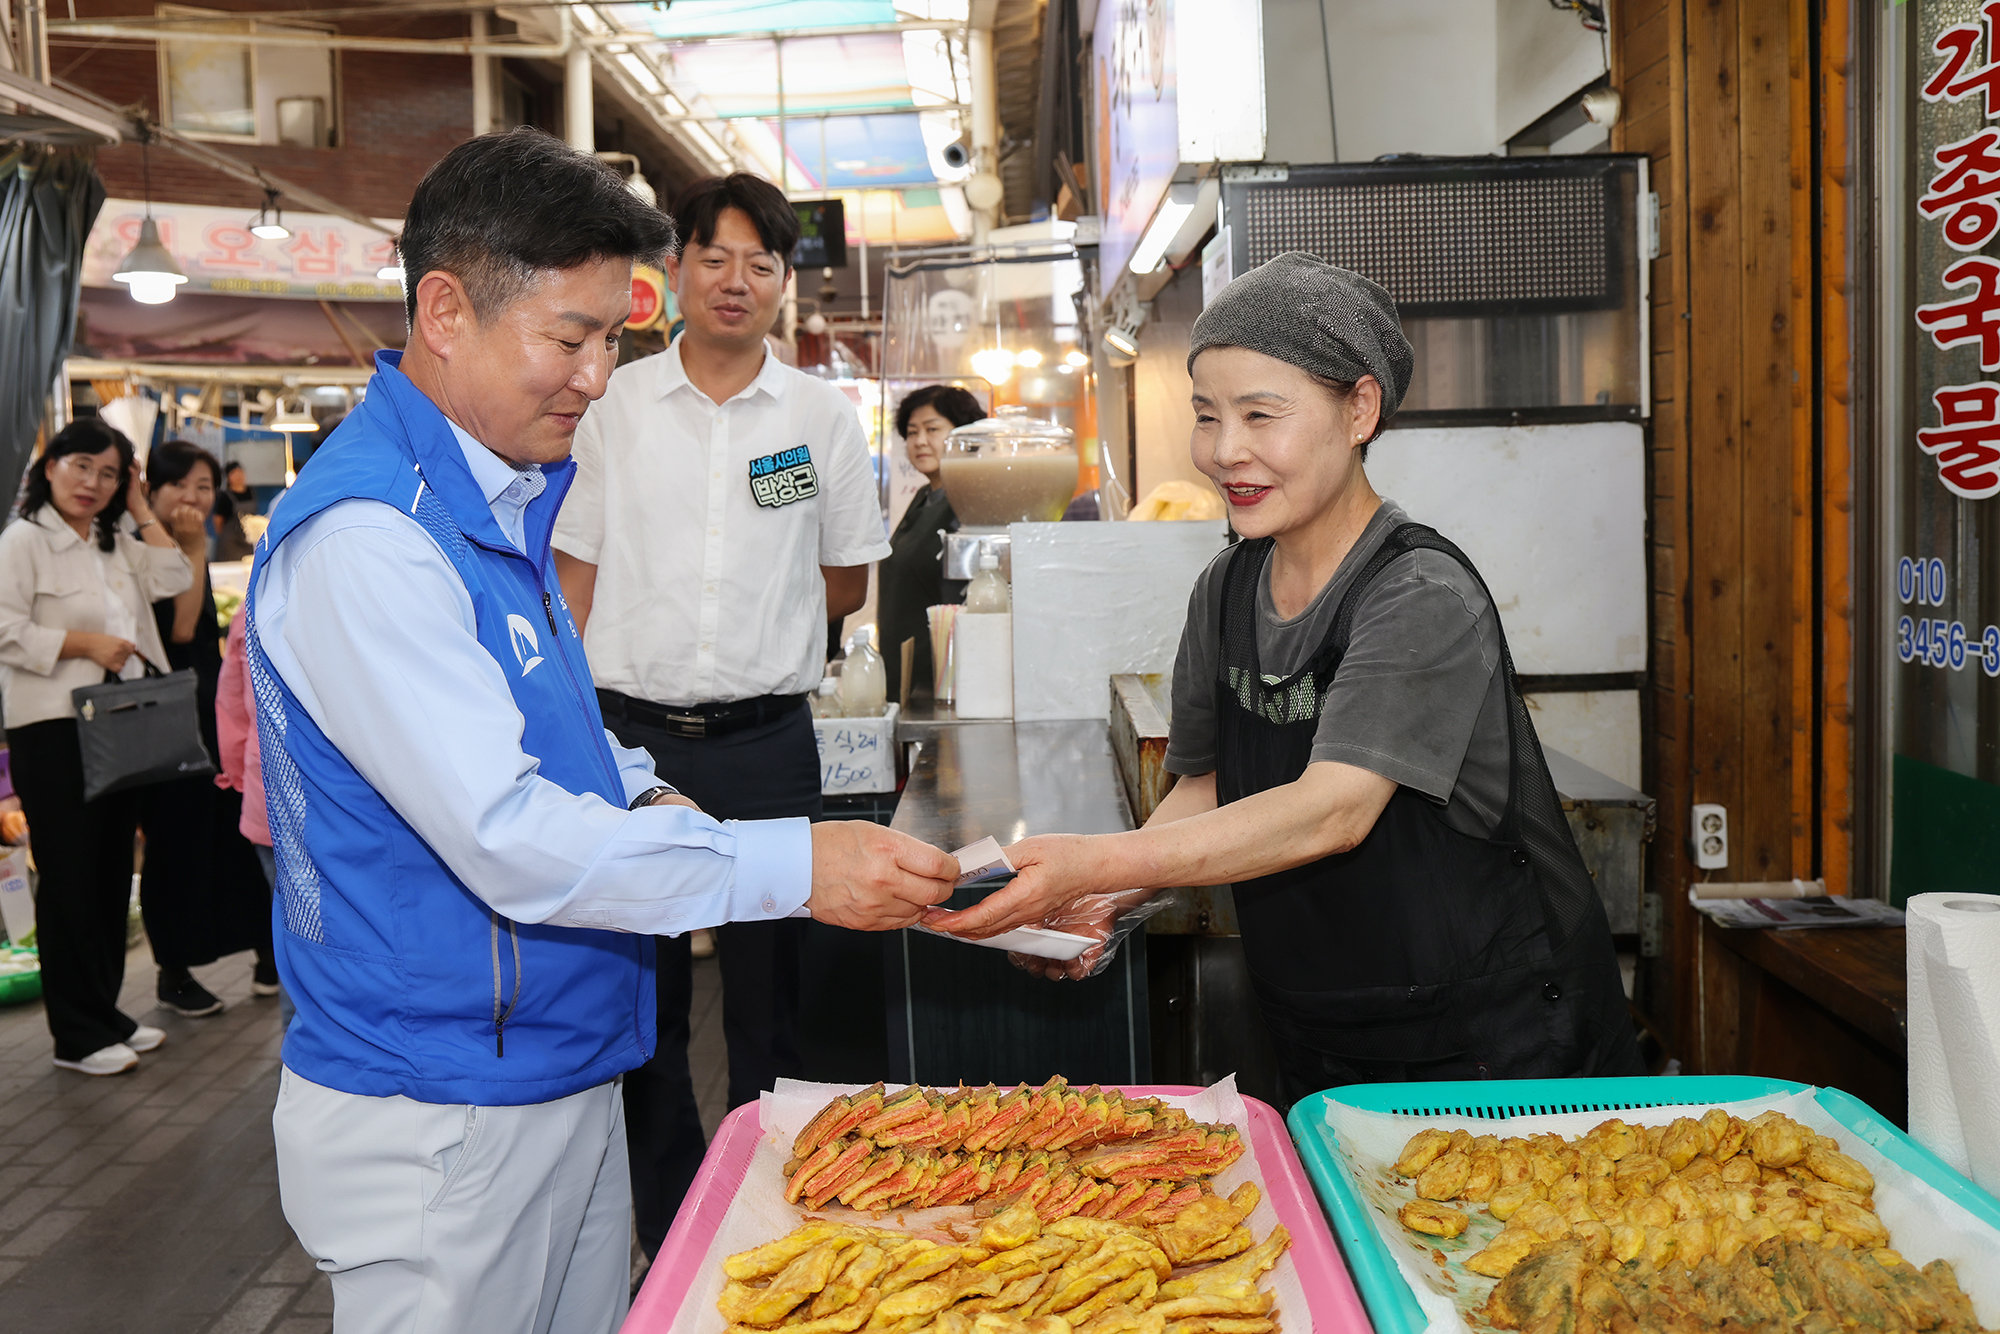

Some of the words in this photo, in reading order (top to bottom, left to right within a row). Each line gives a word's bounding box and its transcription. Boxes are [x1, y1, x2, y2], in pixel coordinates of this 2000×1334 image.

[750, 445, 810, 477] 서울시의원
[754, 465, 817, 504] 박상근
[1898, 556, 1946, 607] 010
[1898, 615, 2000, 677] 3456-3
[823, 762, 872, 788] 1500
